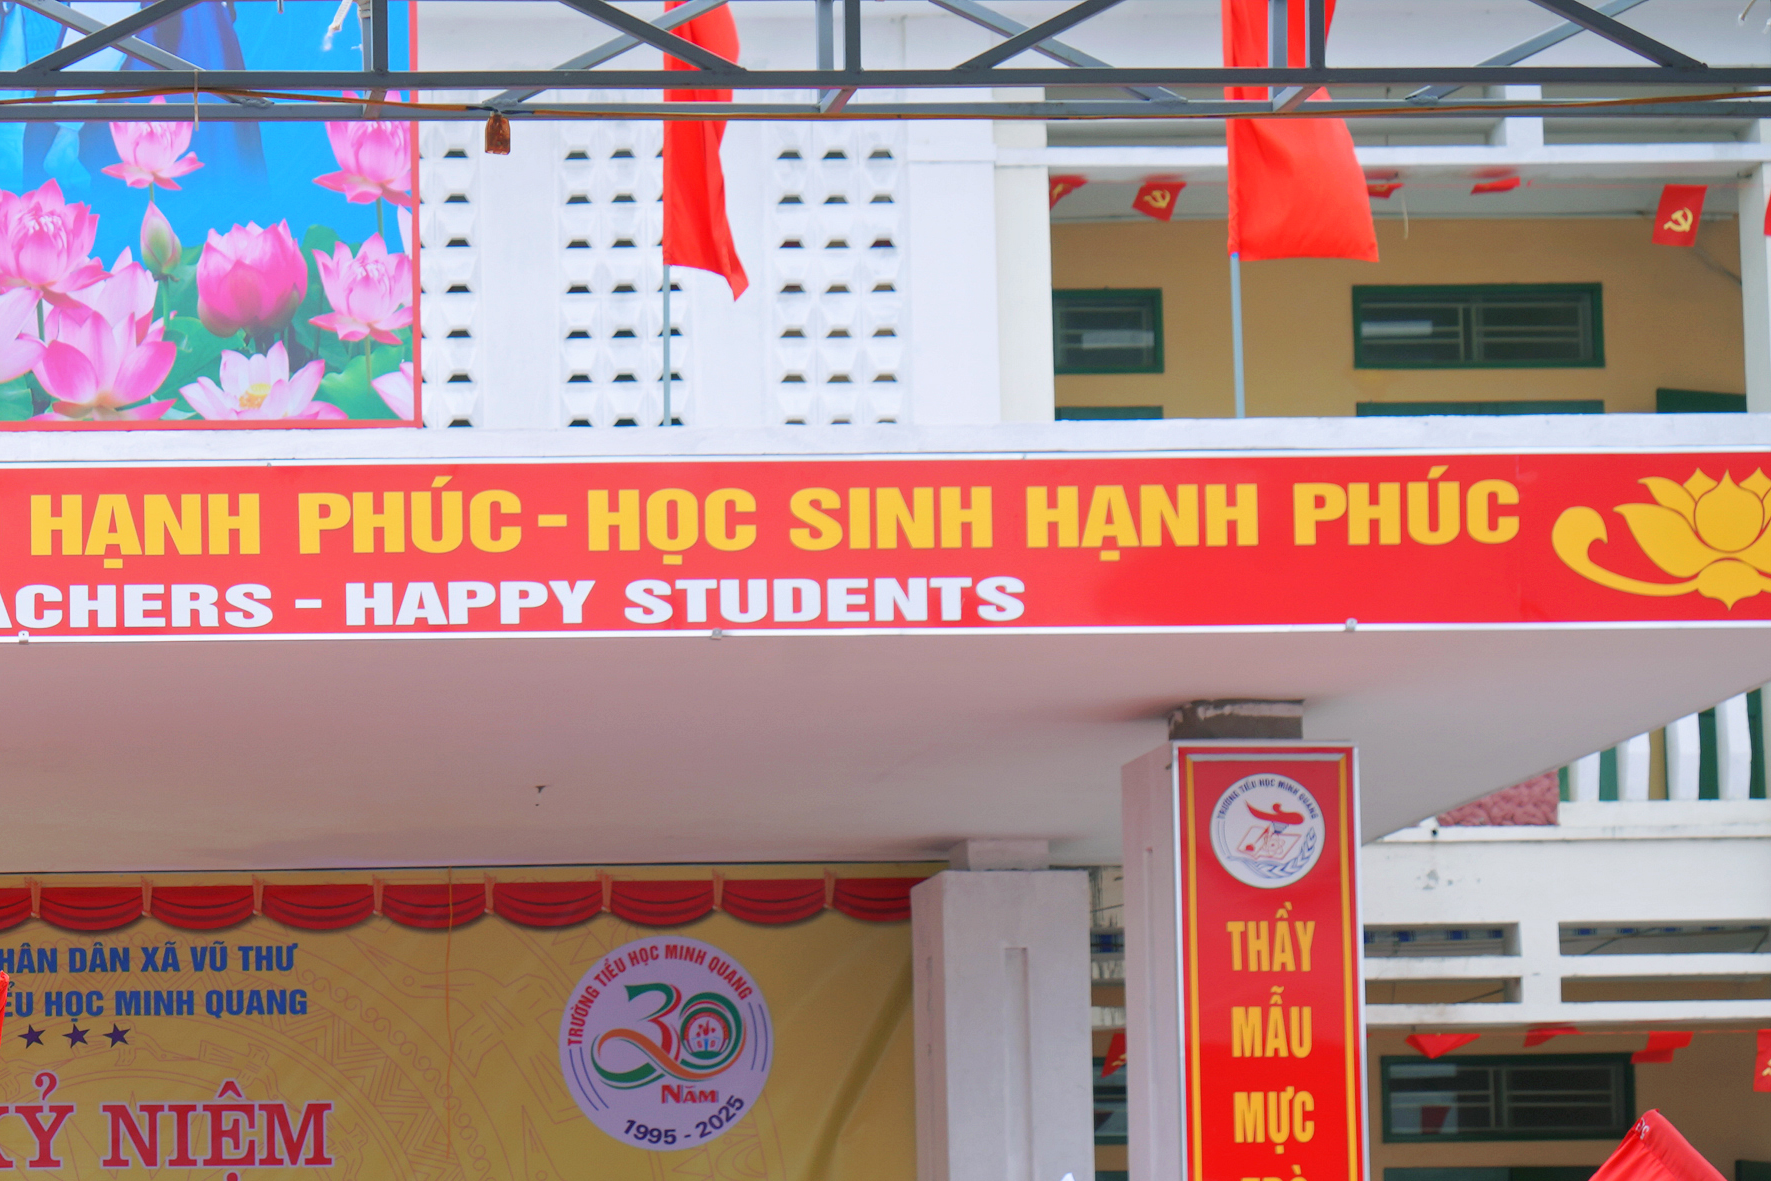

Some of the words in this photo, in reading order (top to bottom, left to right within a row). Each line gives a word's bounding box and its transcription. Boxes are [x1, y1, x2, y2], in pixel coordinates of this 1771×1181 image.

[31, 493, 260, 569] HẠNH
[299, 476, 521, 554] PHÚC
[588, 488, 757, 565] HỌC
[790, 486, 993, 551] SINH
[1026, 483, 1259, 561] HẠNH
[1294, 465, 1520, 546] PHÚC
[346, 580, 595, 627] HAPPY
[624, 576, 1025, 623] STUDENTS
[69, 942, 130, 973] DÂN
[140, 941, 181, 972] XÃ
[190, 941, 228, 972] VŨ
[238, 942, 299, 972] THƯ
[1226, 901, 1316, 972] THẦY
[45, 990, 104, 1022] HỌC
[115, 990, 194, 1016] MINH
[205, 989, 308, 1018] QUANG
[567, 985, 600, 1046] TRƯỜNG
[594, 958, 627, 987] TIỂU
[627, 945, 659, 967] HỌC
[664, 944, 707, 966] MINH
[708, 956, 753, 1000] QUANG
[1231, 985, 1312, 1058] MẪU
[623, 1119, 677, 1145] 1995
[695, 1094, 745, 1138] 2025
[1233, 1086, 1315, 1154] MỰC
